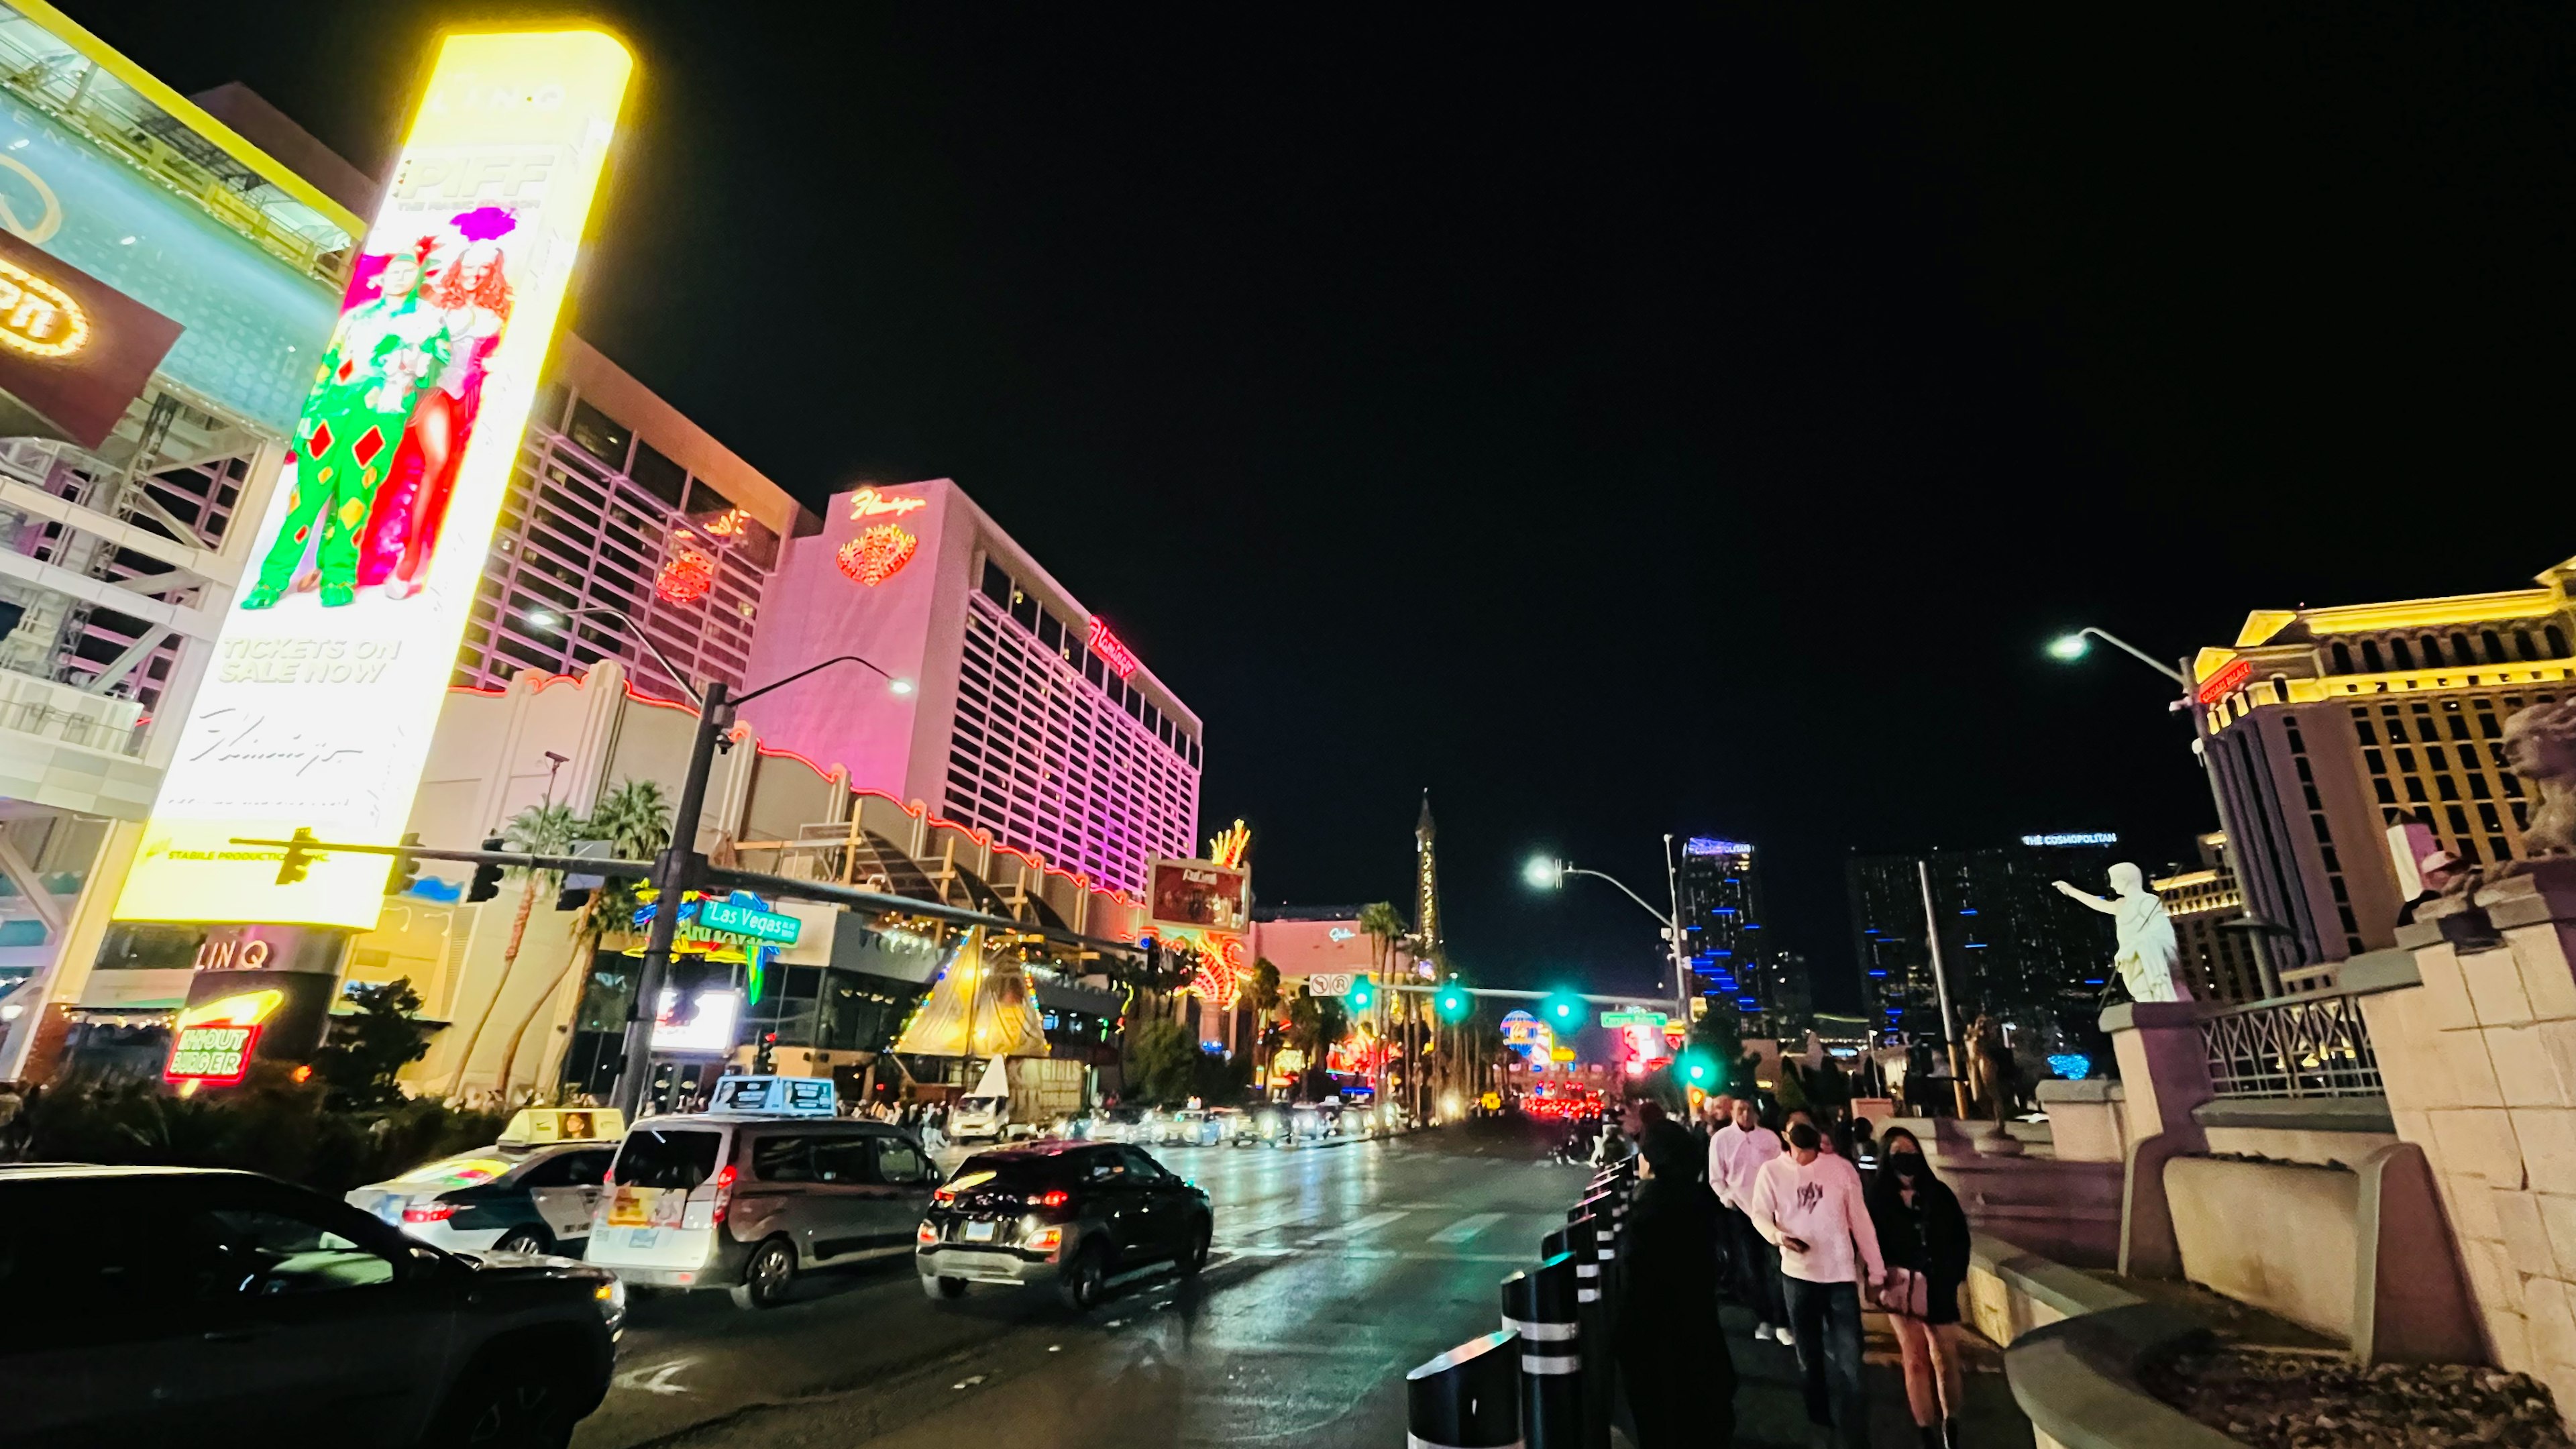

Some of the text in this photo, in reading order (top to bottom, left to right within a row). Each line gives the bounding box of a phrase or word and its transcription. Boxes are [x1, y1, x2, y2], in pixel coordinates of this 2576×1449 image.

[400, 155, 555, 199] PIFF
[223, 639, 402, 660] TICKETS ON
[1089, 615, 1135, 676] Flamingo
[218, 662, 387, 684] SALE NOW
[2022, 833, 2117, 846] THE COSMOPOLITAN
[710, 902, 737, 924] Las
[741, 908, 782, 936] Vegas
